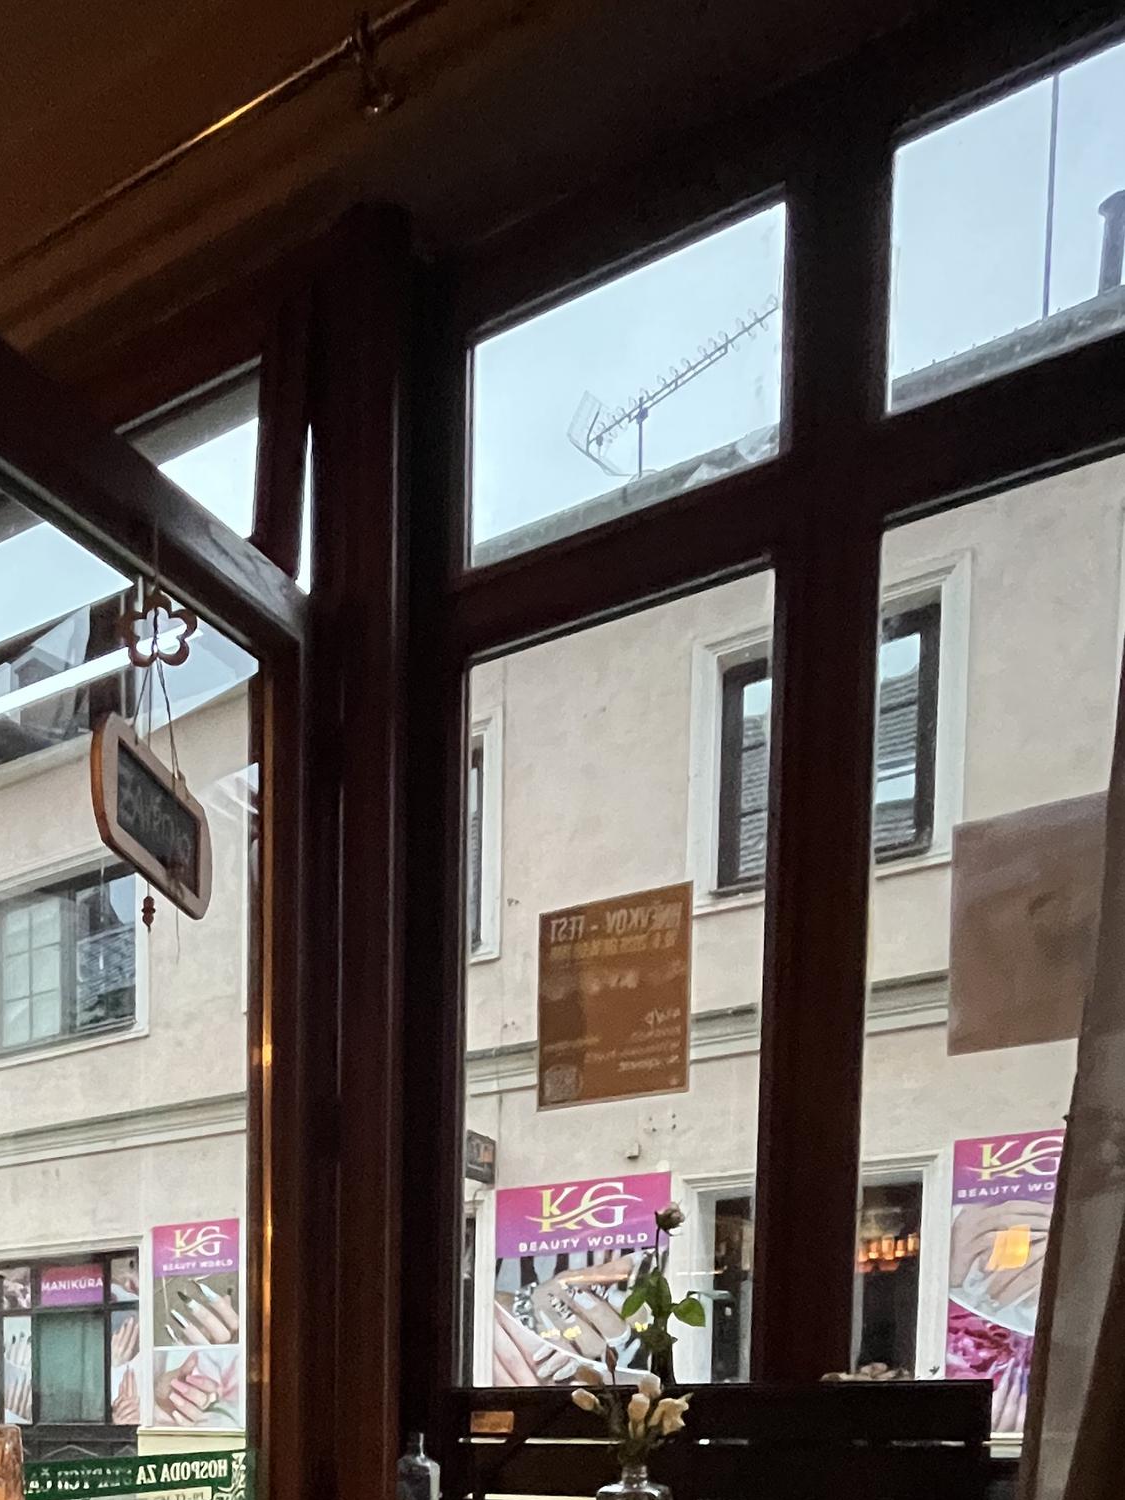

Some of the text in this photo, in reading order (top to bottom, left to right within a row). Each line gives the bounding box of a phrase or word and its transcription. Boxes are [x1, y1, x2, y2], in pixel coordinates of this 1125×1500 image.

[975, 1135, 1064, 1181] KG
[956, 1184, 1021, 1199] BEAUTY
[535, 1181, 631, 1233] KG
[172, 1224, 224, 1258] KG
[518, 1232, 649, 1253] BEAUTY WORLD
[162, 1257, 234, 1272] BEAUTY WORLD
